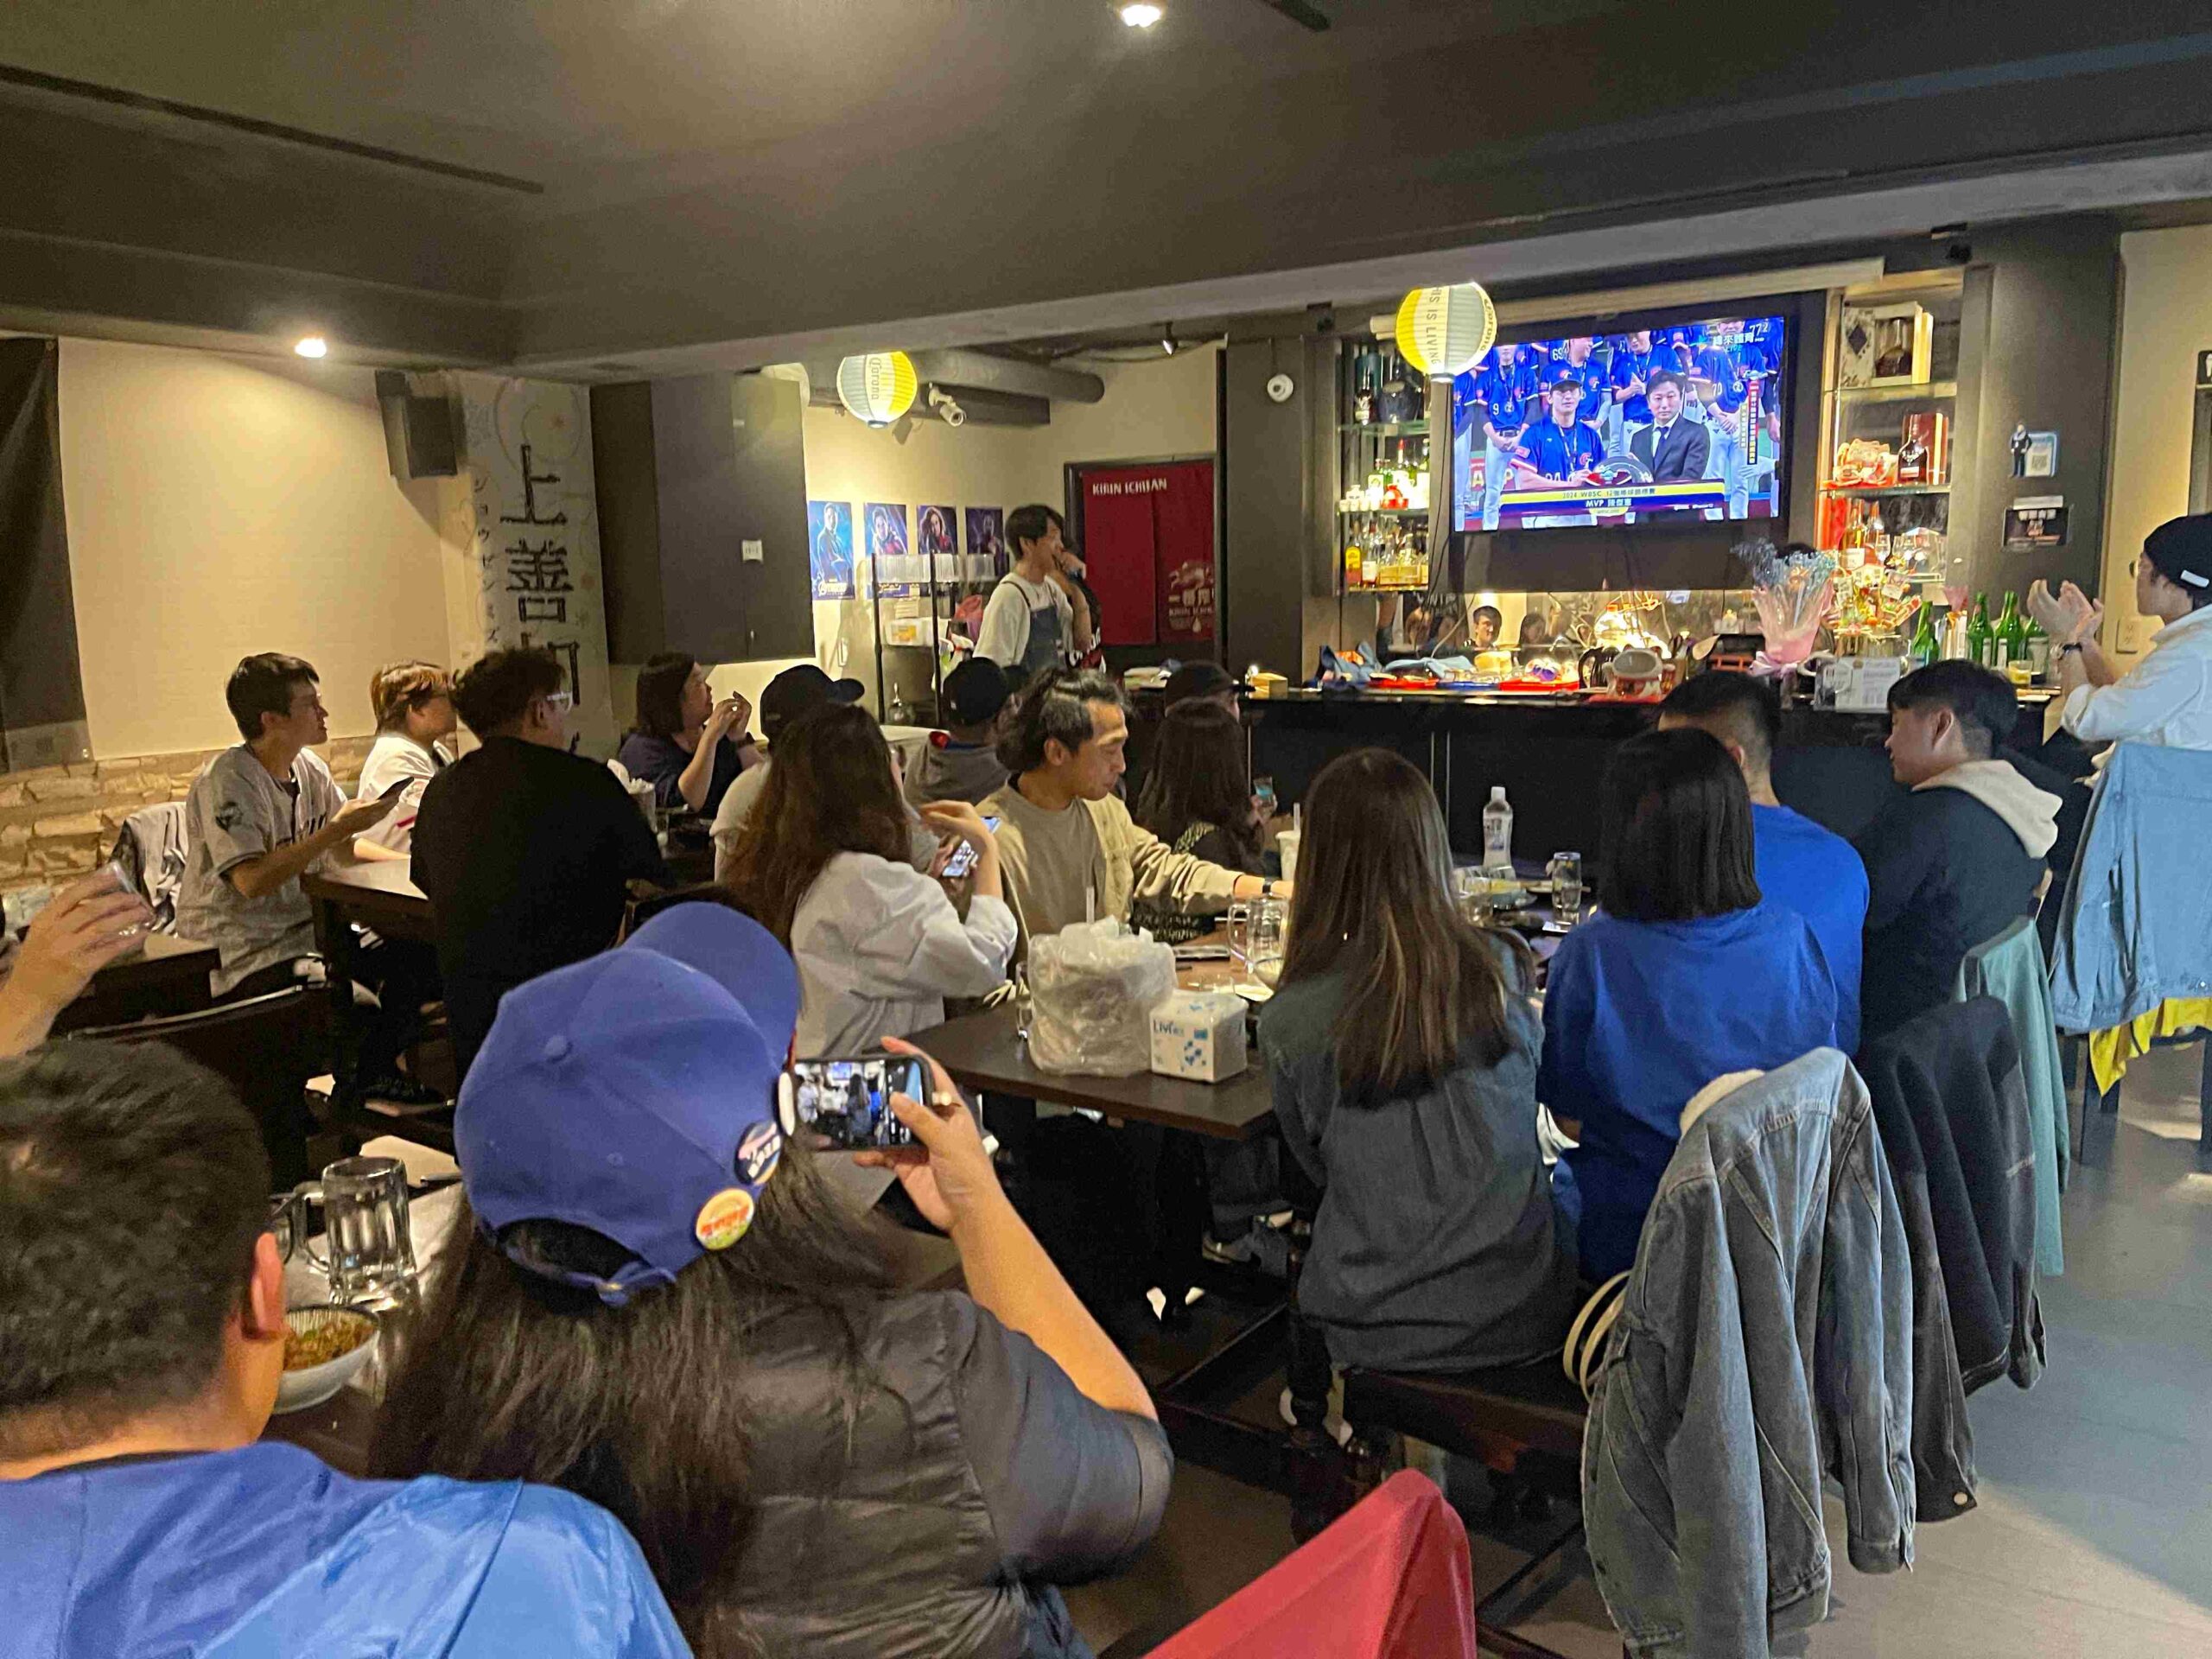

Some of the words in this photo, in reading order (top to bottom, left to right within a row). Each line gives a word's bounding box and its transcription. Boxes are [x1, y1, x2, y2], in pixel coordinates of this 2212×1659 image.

[1429, 287, 1442, 303] HIS
[1427, 309, 1439, 321] IS
[1426, 326, 1442, 365] LIVING
[868, 356, 882, 400] Corona
[1492, 403, 1500, 416] 9
[1092, 482, 1122, 495] KIRIN
